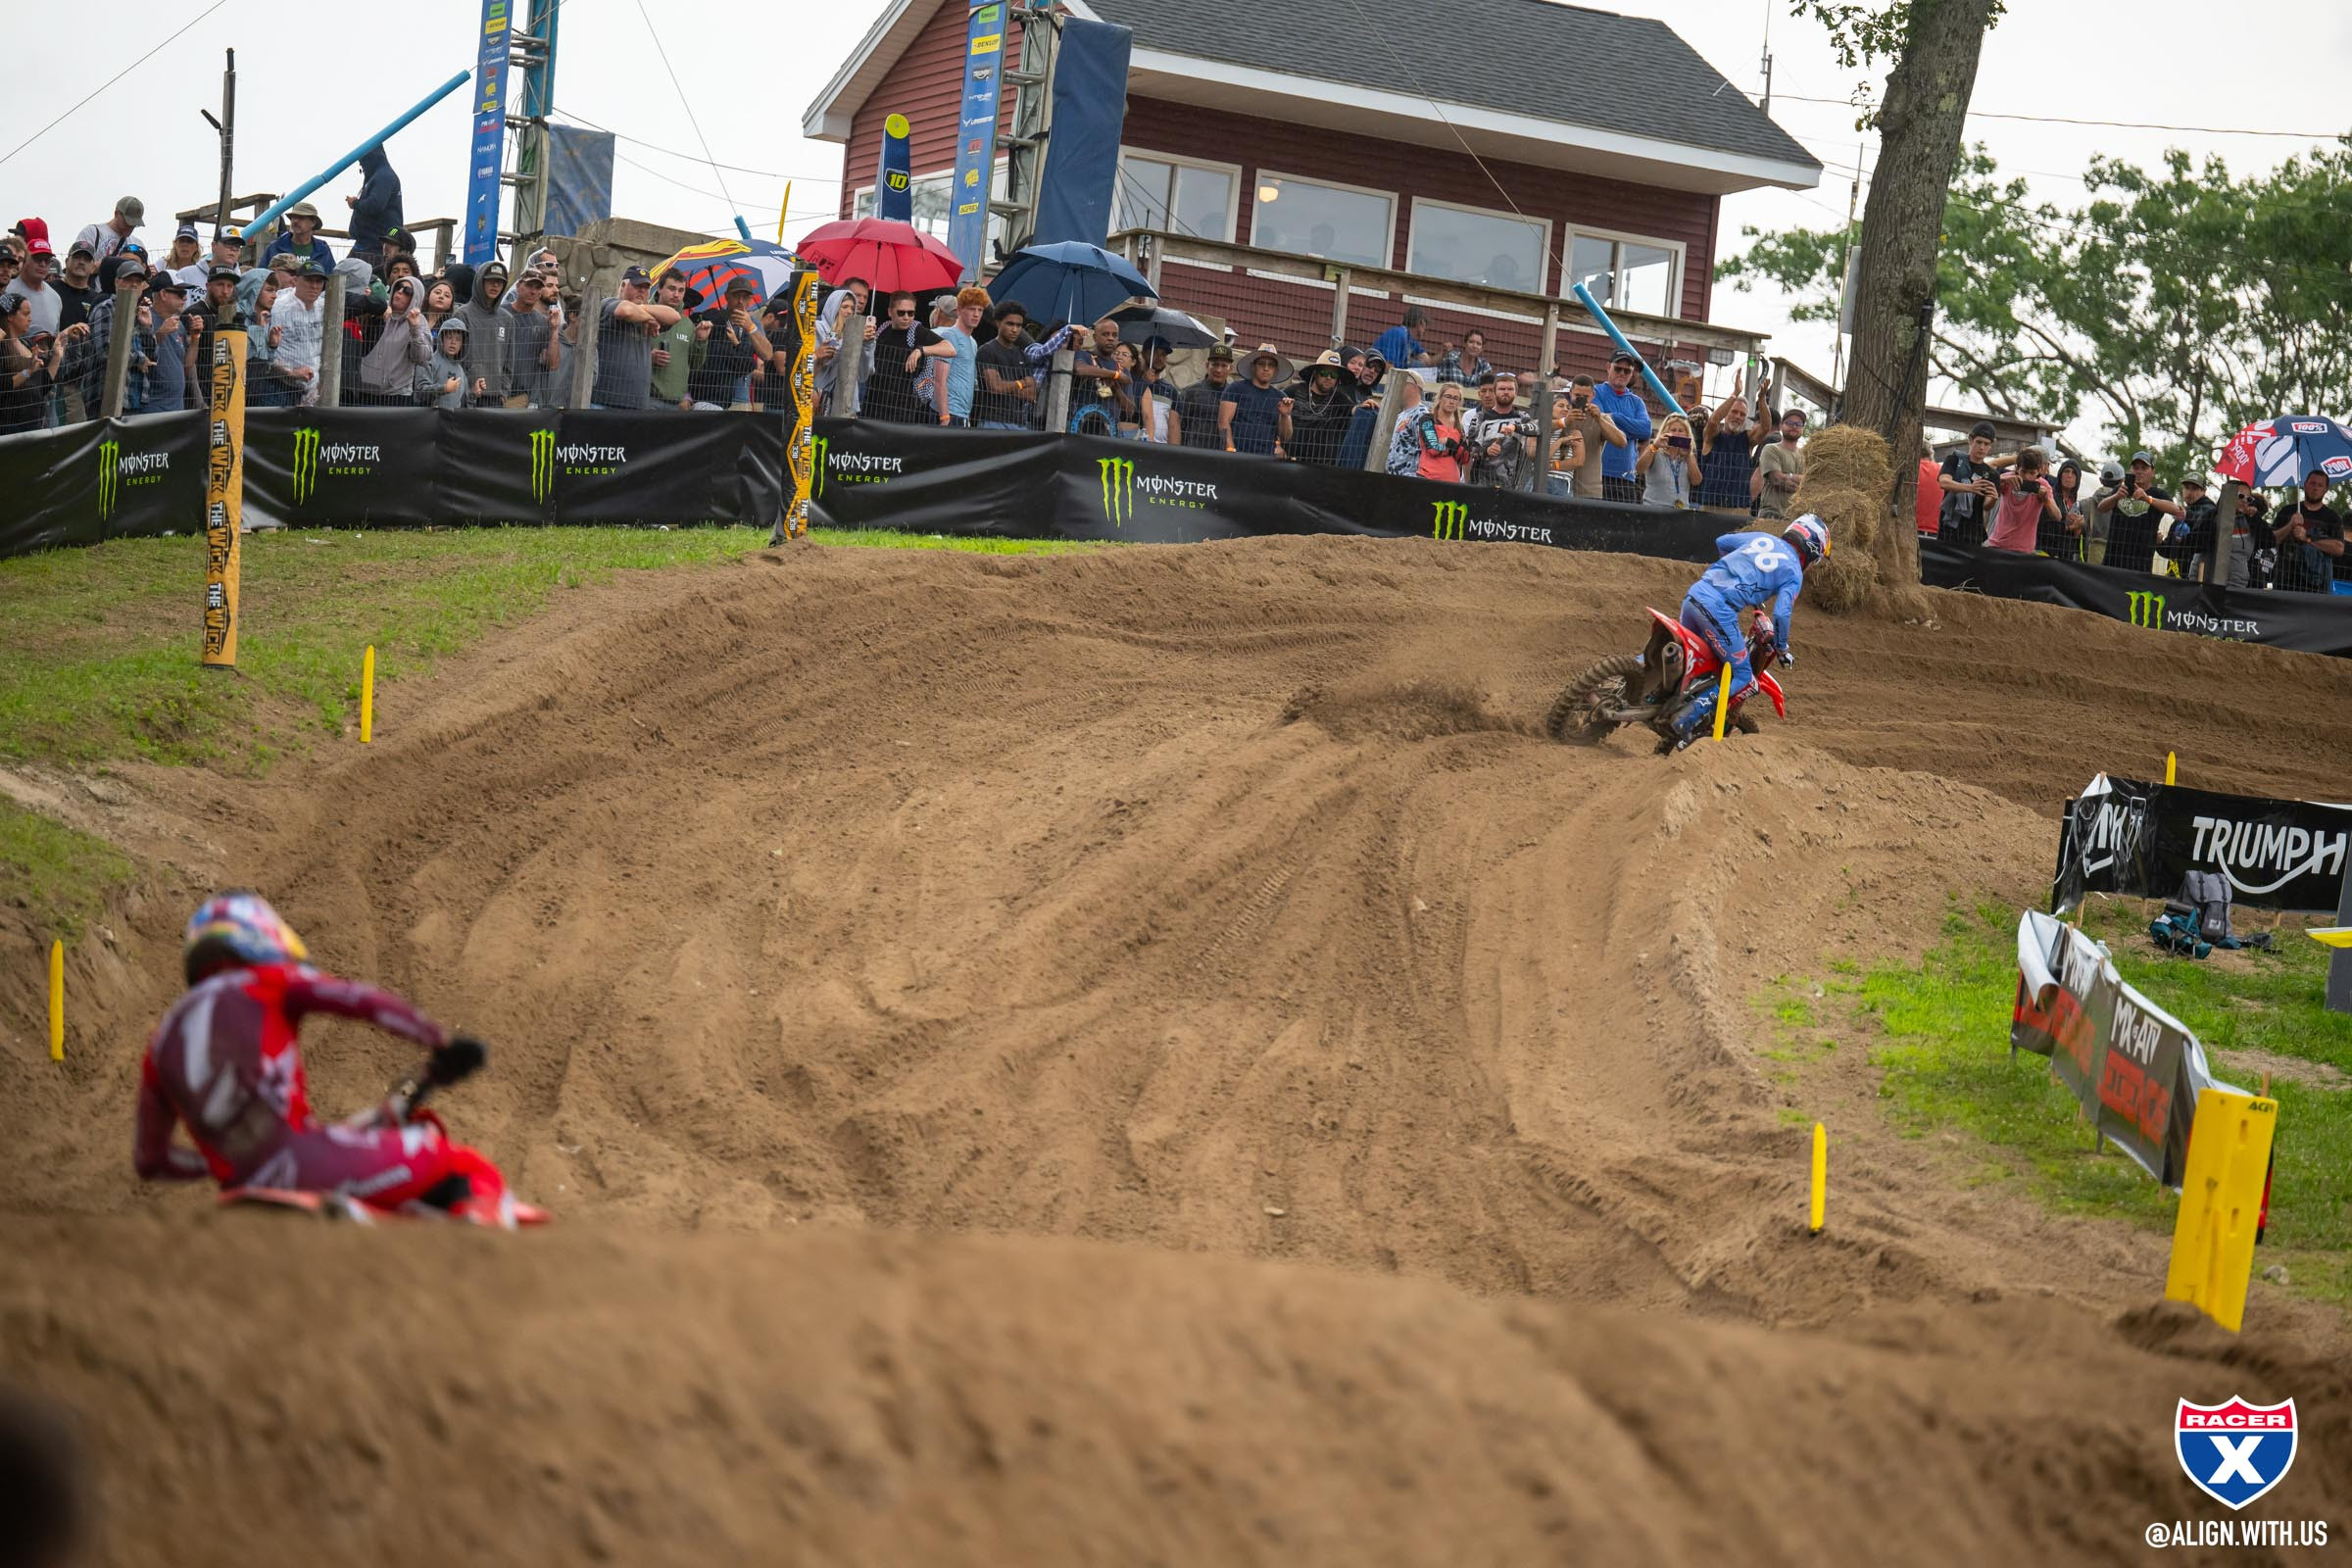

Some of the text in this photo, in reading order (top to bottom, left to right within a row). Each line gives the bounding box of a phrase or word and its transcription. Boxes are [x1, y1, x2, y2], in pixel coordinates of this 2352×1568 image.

[890, 173, 907, 189] 10
[213, 338, 231, 413] THE WICK
[119, 451, 170, 475] MONSTER
[211, 419, 229, 493] THE WICK
[319, 441, 380, 464] MONSTER
[556, 443, 627, 465] MONSTER
[828, 451, 902, 472] MONSTER
[126, 474, 162, 486] ENERGY
[328, 466, 371, 475] ENERGY
[565, 466, 617, 475] ENERGY
[837, 473, 890, 484] ENERGY
[1136, 474, 1218, 500] MONSTER
[801, 499, 809, 517] THE
[1149, 496, 1205, 510] ENERGY
[209, 501, 227, 575] THE WICK
[1468, 518, 1553, 544] MONSTER
[1741, 536, 1789, 573] 96
[206, 582, 224, 656] THE WICK
[2167, 610, 2261, 635] MONSTER
[2192, 815, 2347, 894] TRIUMPH
